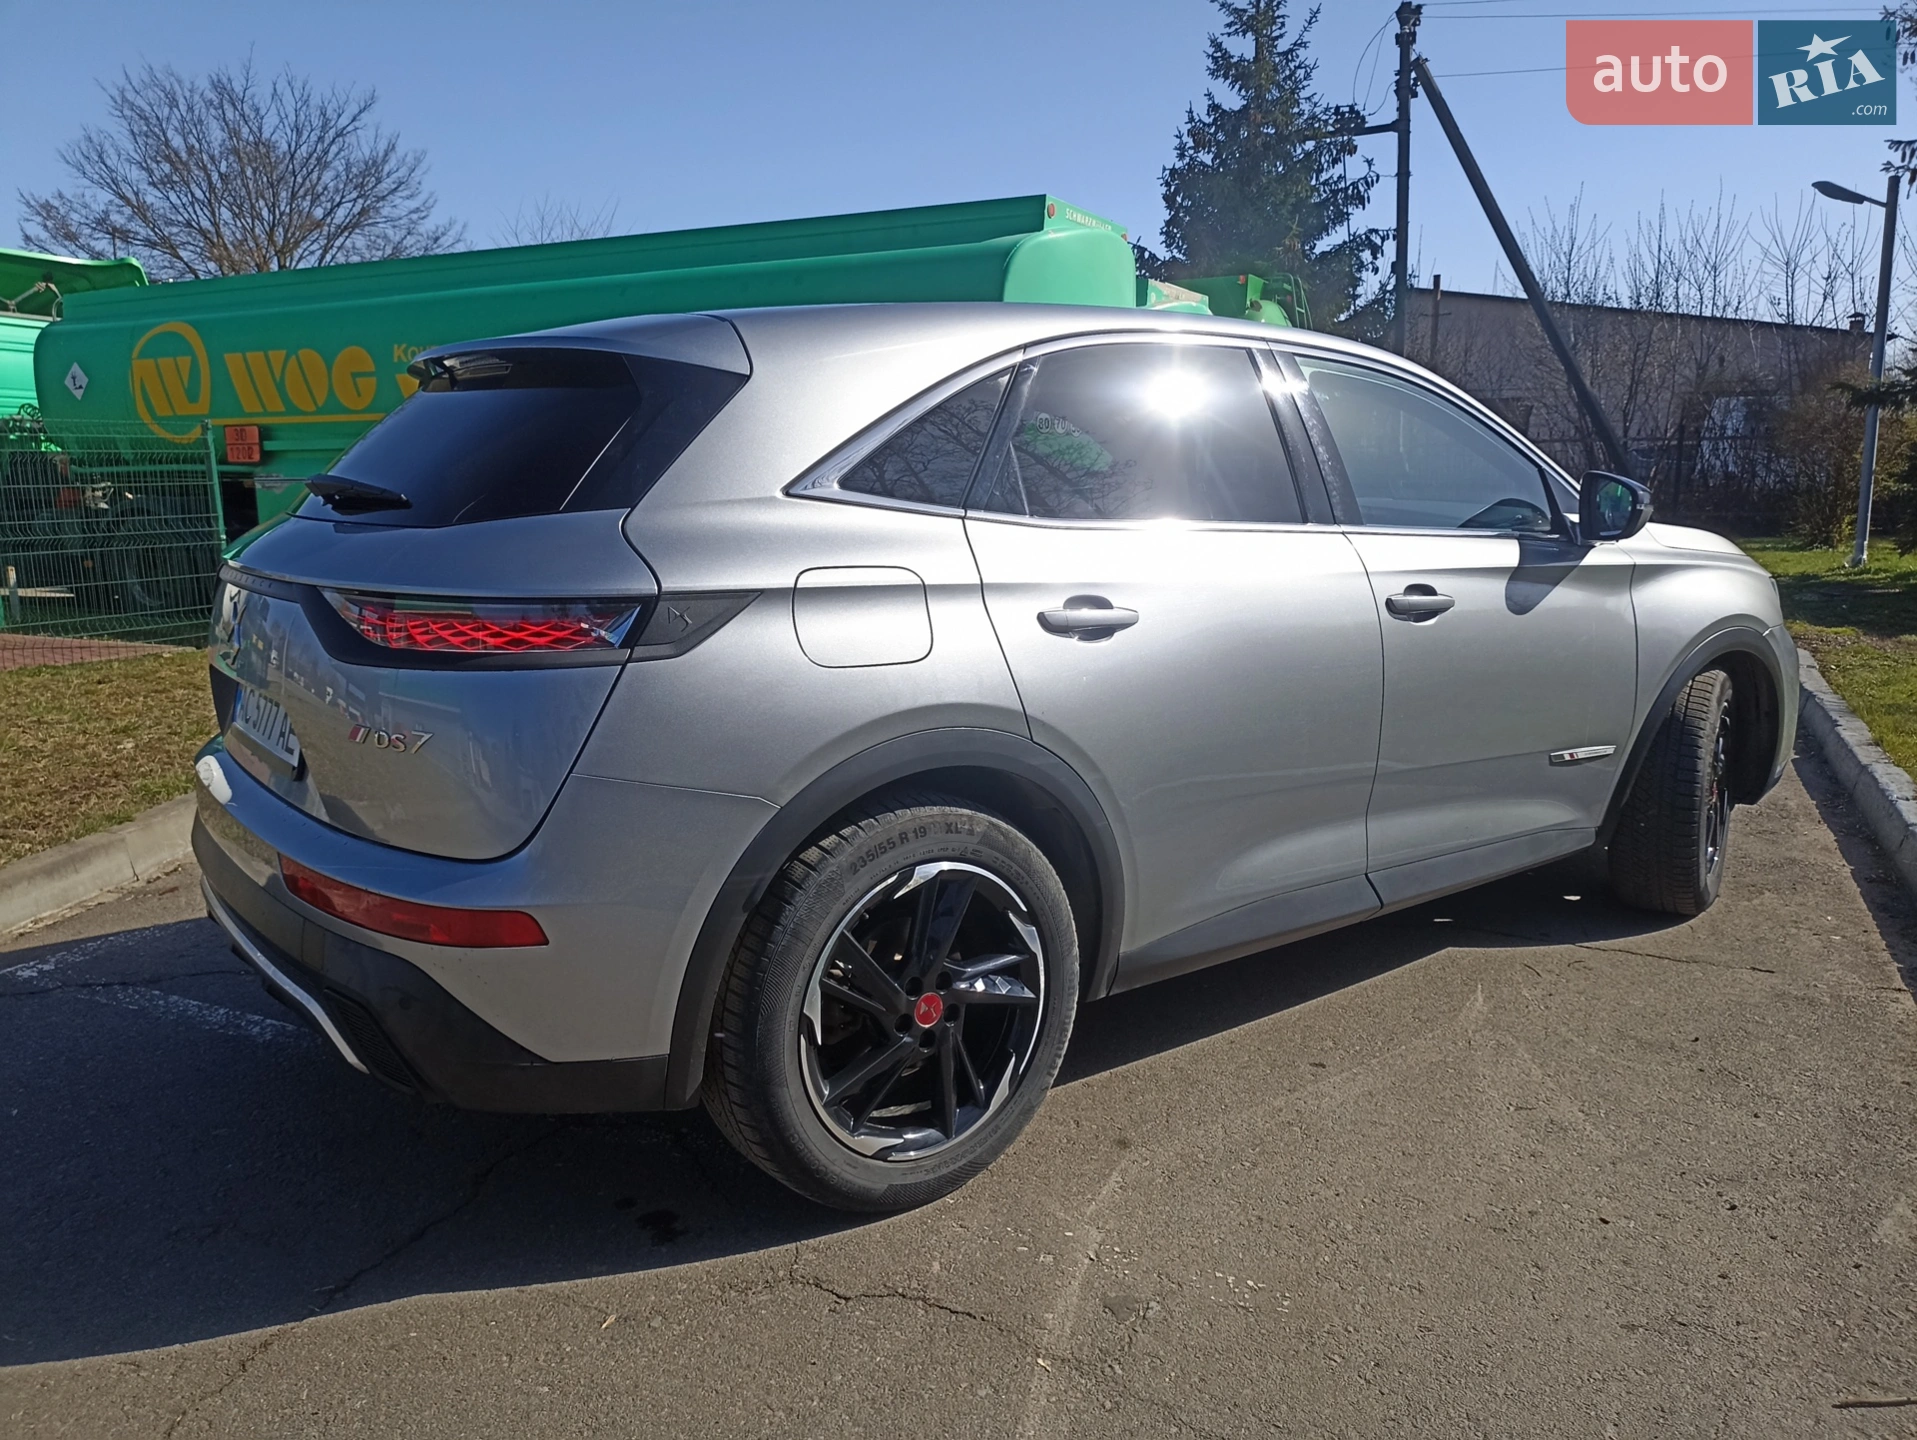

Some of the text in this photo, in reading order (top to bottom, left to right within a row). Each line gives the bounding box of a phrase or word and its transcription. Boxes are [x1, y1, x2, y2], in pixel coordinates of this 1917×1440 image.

[224, 346, 377, 413] WOG
[851, 838, 897, 876] 235/55
[899, 831, 911, 846] R
[912, 825, 928, 840] 19
